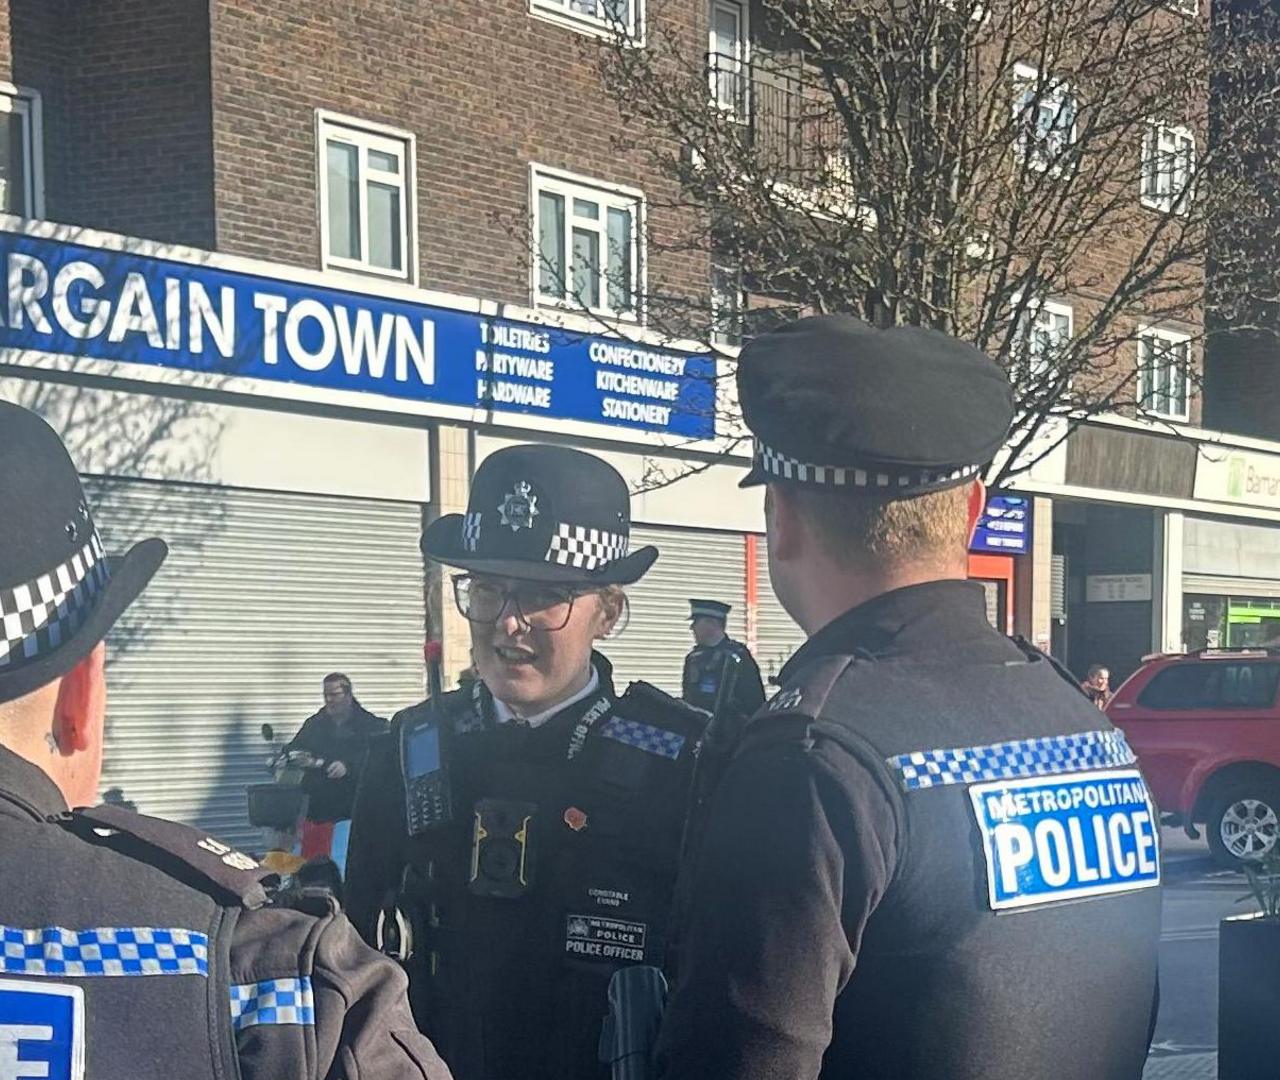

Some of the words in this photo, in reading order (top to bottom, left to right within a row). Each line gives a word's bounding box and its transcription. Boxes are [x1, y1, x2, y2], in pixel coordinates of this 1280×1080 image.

[254, 292, 436, 385] TOWN
[589, 342, 687, 376] CONFECTIONERY
[596, 370, 679, 401] KITCHENWARE
[602, 398, 672, 426] STATIONERY
[987, 781, 1149, 820] METROPOLITAN
[994, 811, 1156, 893] POLICE
[566, 940, 602, 956] POLICE
[603, 945, 644, 960] OFFICER
[597, 930, 635, 943] POLICE
